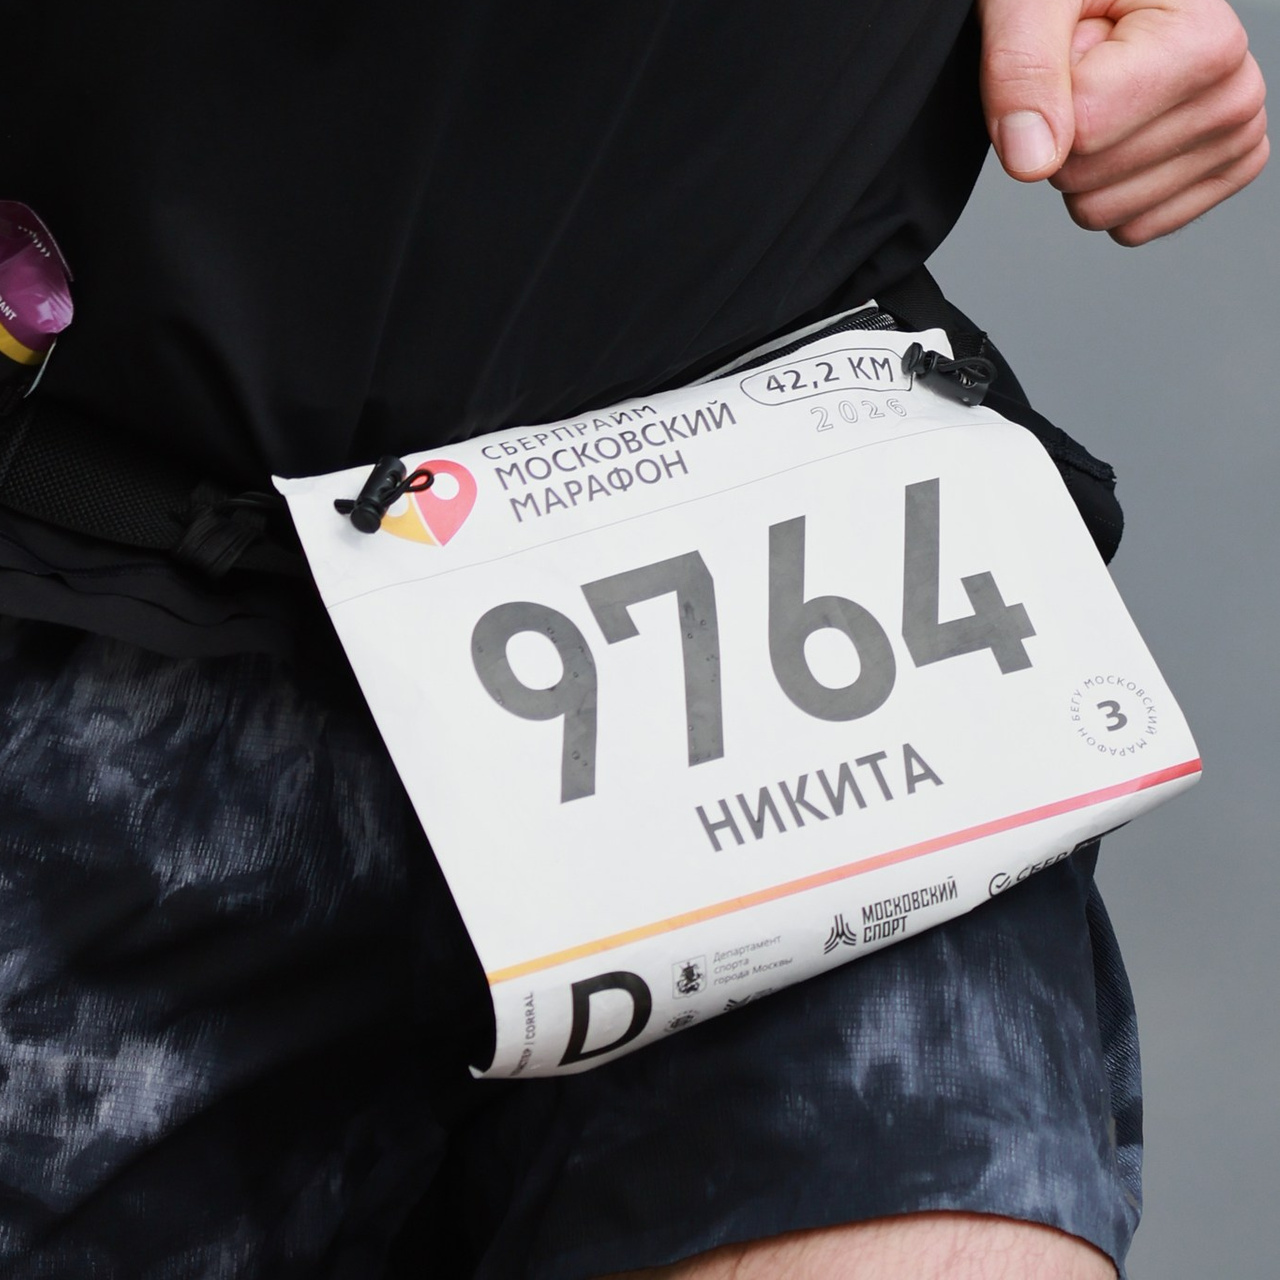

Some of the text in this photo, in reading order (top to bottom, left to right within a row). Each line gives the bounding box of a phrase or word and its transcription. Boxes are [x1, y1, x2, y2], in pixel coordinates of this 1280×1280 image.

[766, 356, 894, 393] 42,2 КМ
[481, 404, 657, 460] СБЕРПРАЙМ
[810, 398, 907, 432] 2026
[494, 400, 737, 490] МОСКОВСКИЙ
[509, 449, 689, 522] МАРАФОН
[470, 477, 1037, 804] 9764
[1070, 675, 1158, 757] БЕГУ МОСКОВСКИЙ МАРАФОН
[1096, 699, 1128, 732] 3
[695, 741, 945, 853] НИКИТА
[862, 876, 958, 924] МОСКОВСКИЙ
[713, 935, 781, 963] Департамент
[863, 915, 908, 943] СПОРТ
[713, 957, 793, 986] города Москвы
[714, 957, 750, 975] спорта
[524, 992, 536, 1039] CORRAL
[558, 971, 652, 1067] D
